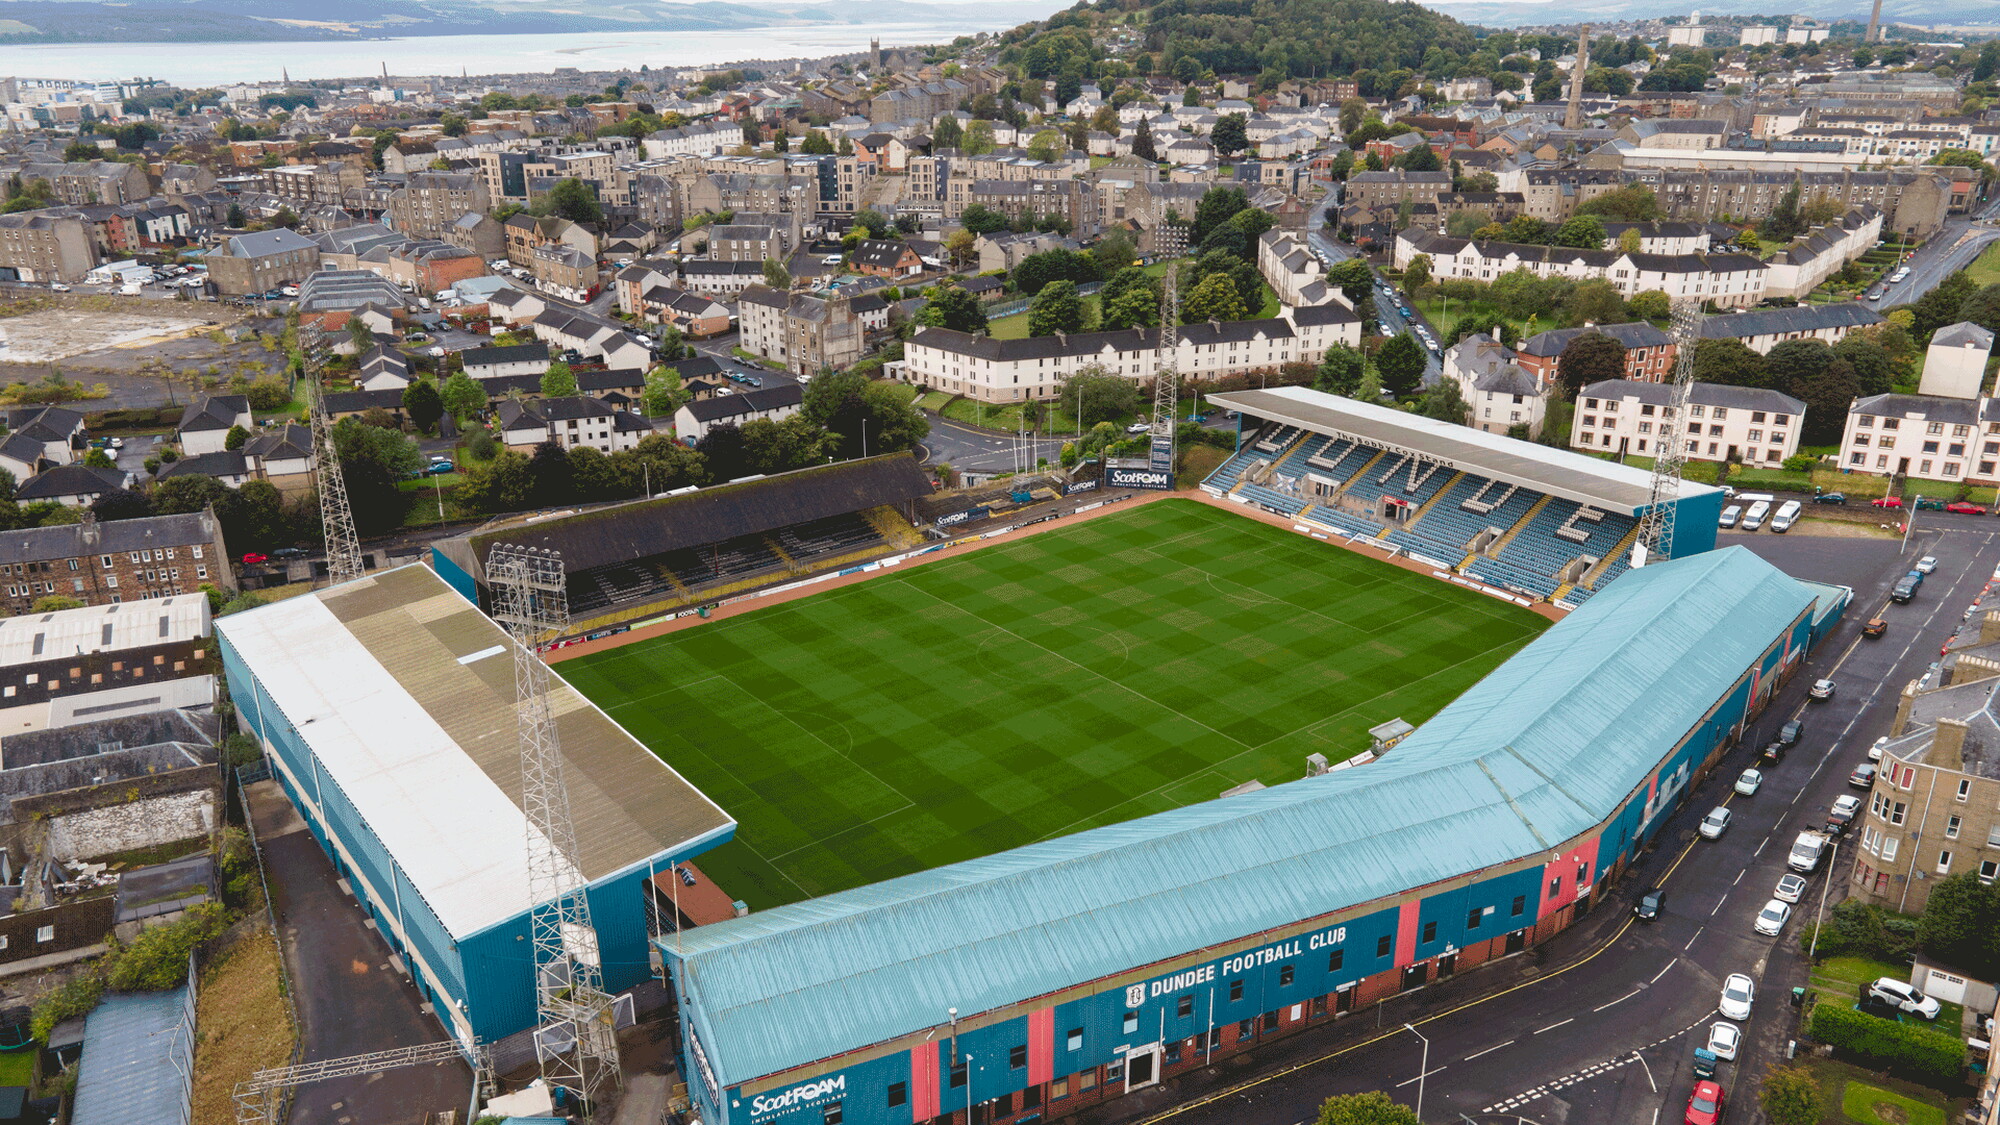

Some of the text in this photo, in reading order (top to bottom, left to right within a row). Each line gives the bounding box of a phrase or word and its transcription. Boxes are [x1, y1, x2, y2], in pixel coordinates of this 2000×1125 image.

[1336, 431, 1454, 468] The Bobby Cox Stand
[1151, 926, 1346, 998] DUNDEE FOOTBALL CLUB
[750, 1074, 846, 1116] ScotFOAM
[751, 1092, 848, 1125] INSULATING SCOTLAND
